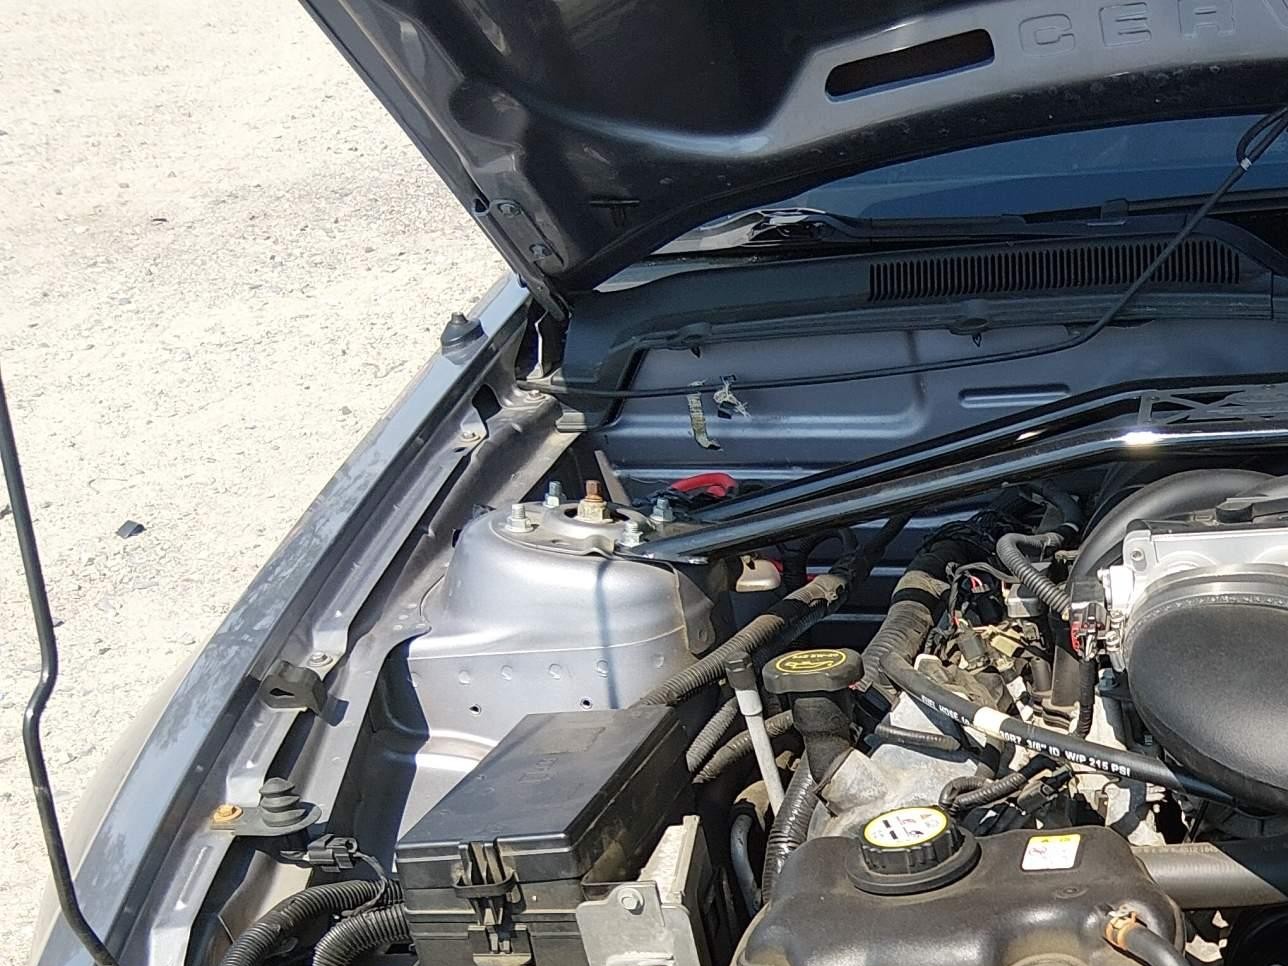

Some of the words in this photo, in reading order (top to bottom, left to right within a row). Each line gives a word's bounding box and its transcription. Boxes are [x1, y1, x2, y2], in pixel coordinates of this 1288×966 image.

[1048, 746, 1061, 757] ID
[1065, 750, 1087, 763] W/P
[1089, 758, 1109, 770] 215
[1110, 764, 1131, 777] PSI
